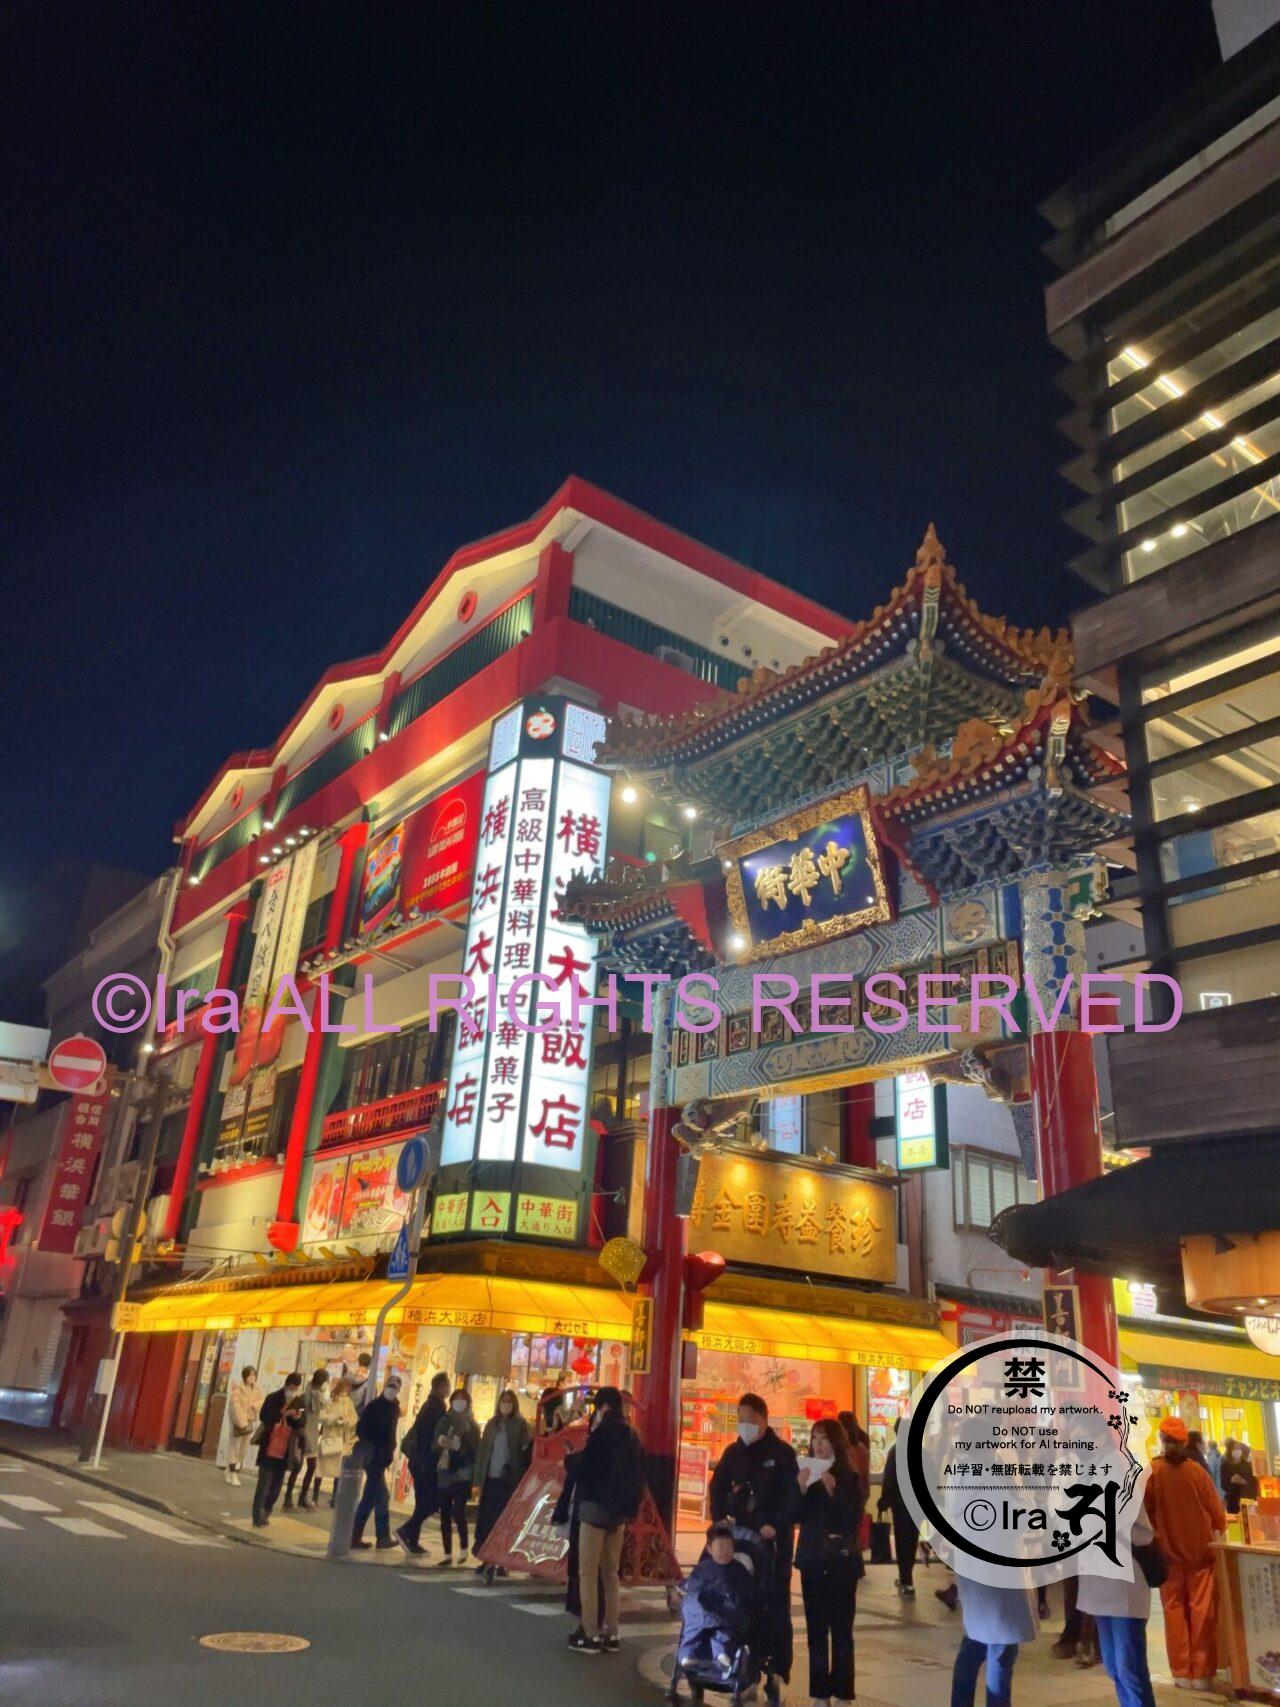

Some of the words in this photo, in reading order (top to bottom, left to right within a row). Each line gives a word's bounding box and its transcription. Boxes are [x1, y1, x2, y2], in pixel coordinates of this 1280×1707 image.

[529, 808, 606, 1151] 横大飯店
[481, 1196, 503, 1228] 入口
[521, 1198, 574, 1223] 中華街
[520, 1219, 573, 1235] 大通り入口
[407, 1309, 487, 1326] 横浜大飯店
